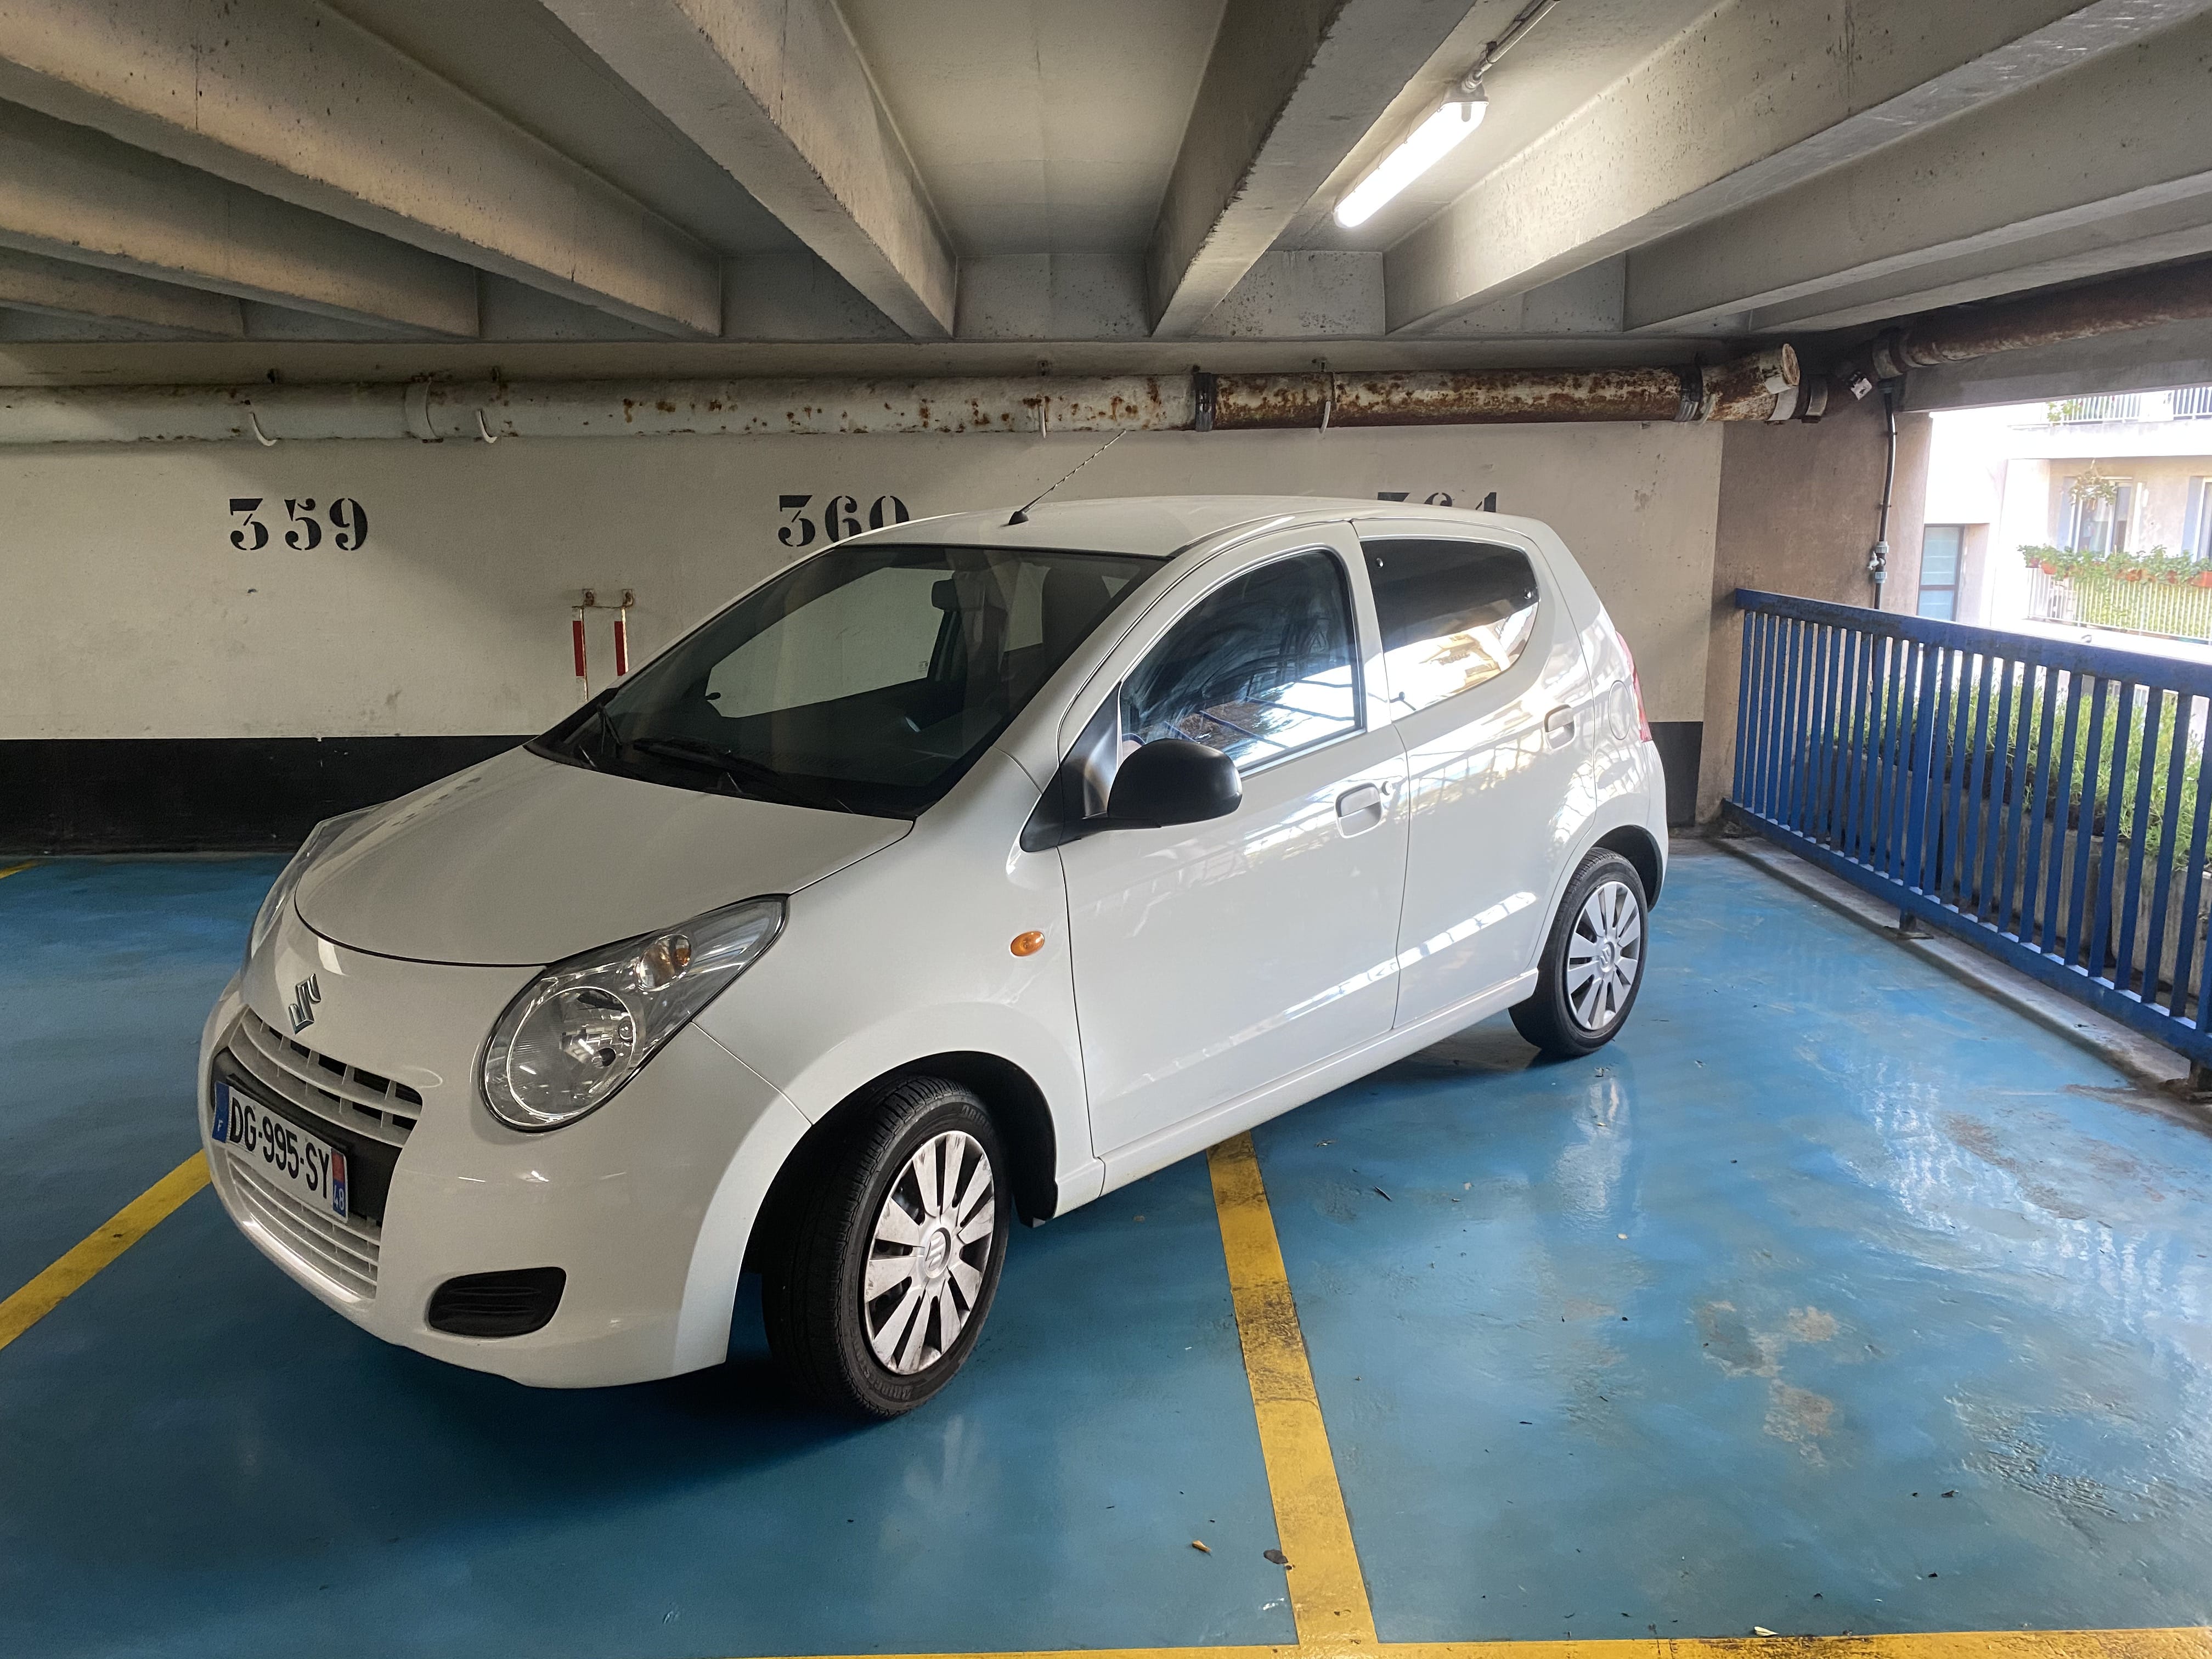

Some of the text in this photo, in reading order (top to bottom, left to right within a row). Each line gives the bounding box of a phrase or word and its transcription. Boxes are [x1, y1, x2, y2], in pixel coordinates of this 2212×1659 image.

[229, 498, 368, 551] 359
[778, 495, 910, 547] 360
[229, 1097, 330, 1199] DG-995-SY
[334, 1184, 345, 1210] 48
